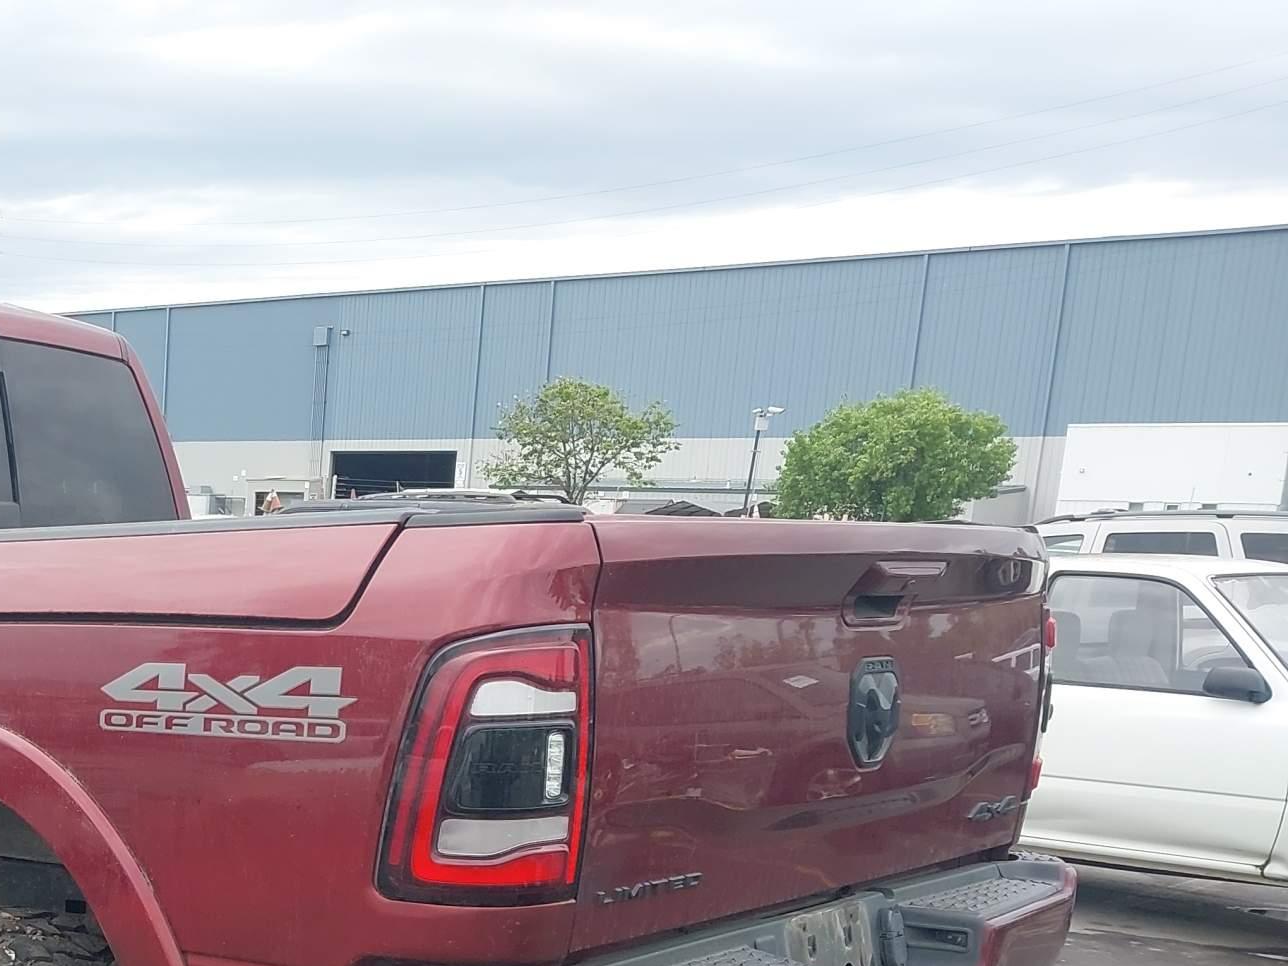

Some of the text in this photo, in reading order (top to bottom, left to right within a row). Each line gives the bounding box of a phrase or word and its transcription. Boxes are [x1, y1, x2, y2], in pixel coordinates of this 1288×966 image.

[103, 711, 343, 740] OFF ROAD
[596, 872, 704, 904] LIMITED
